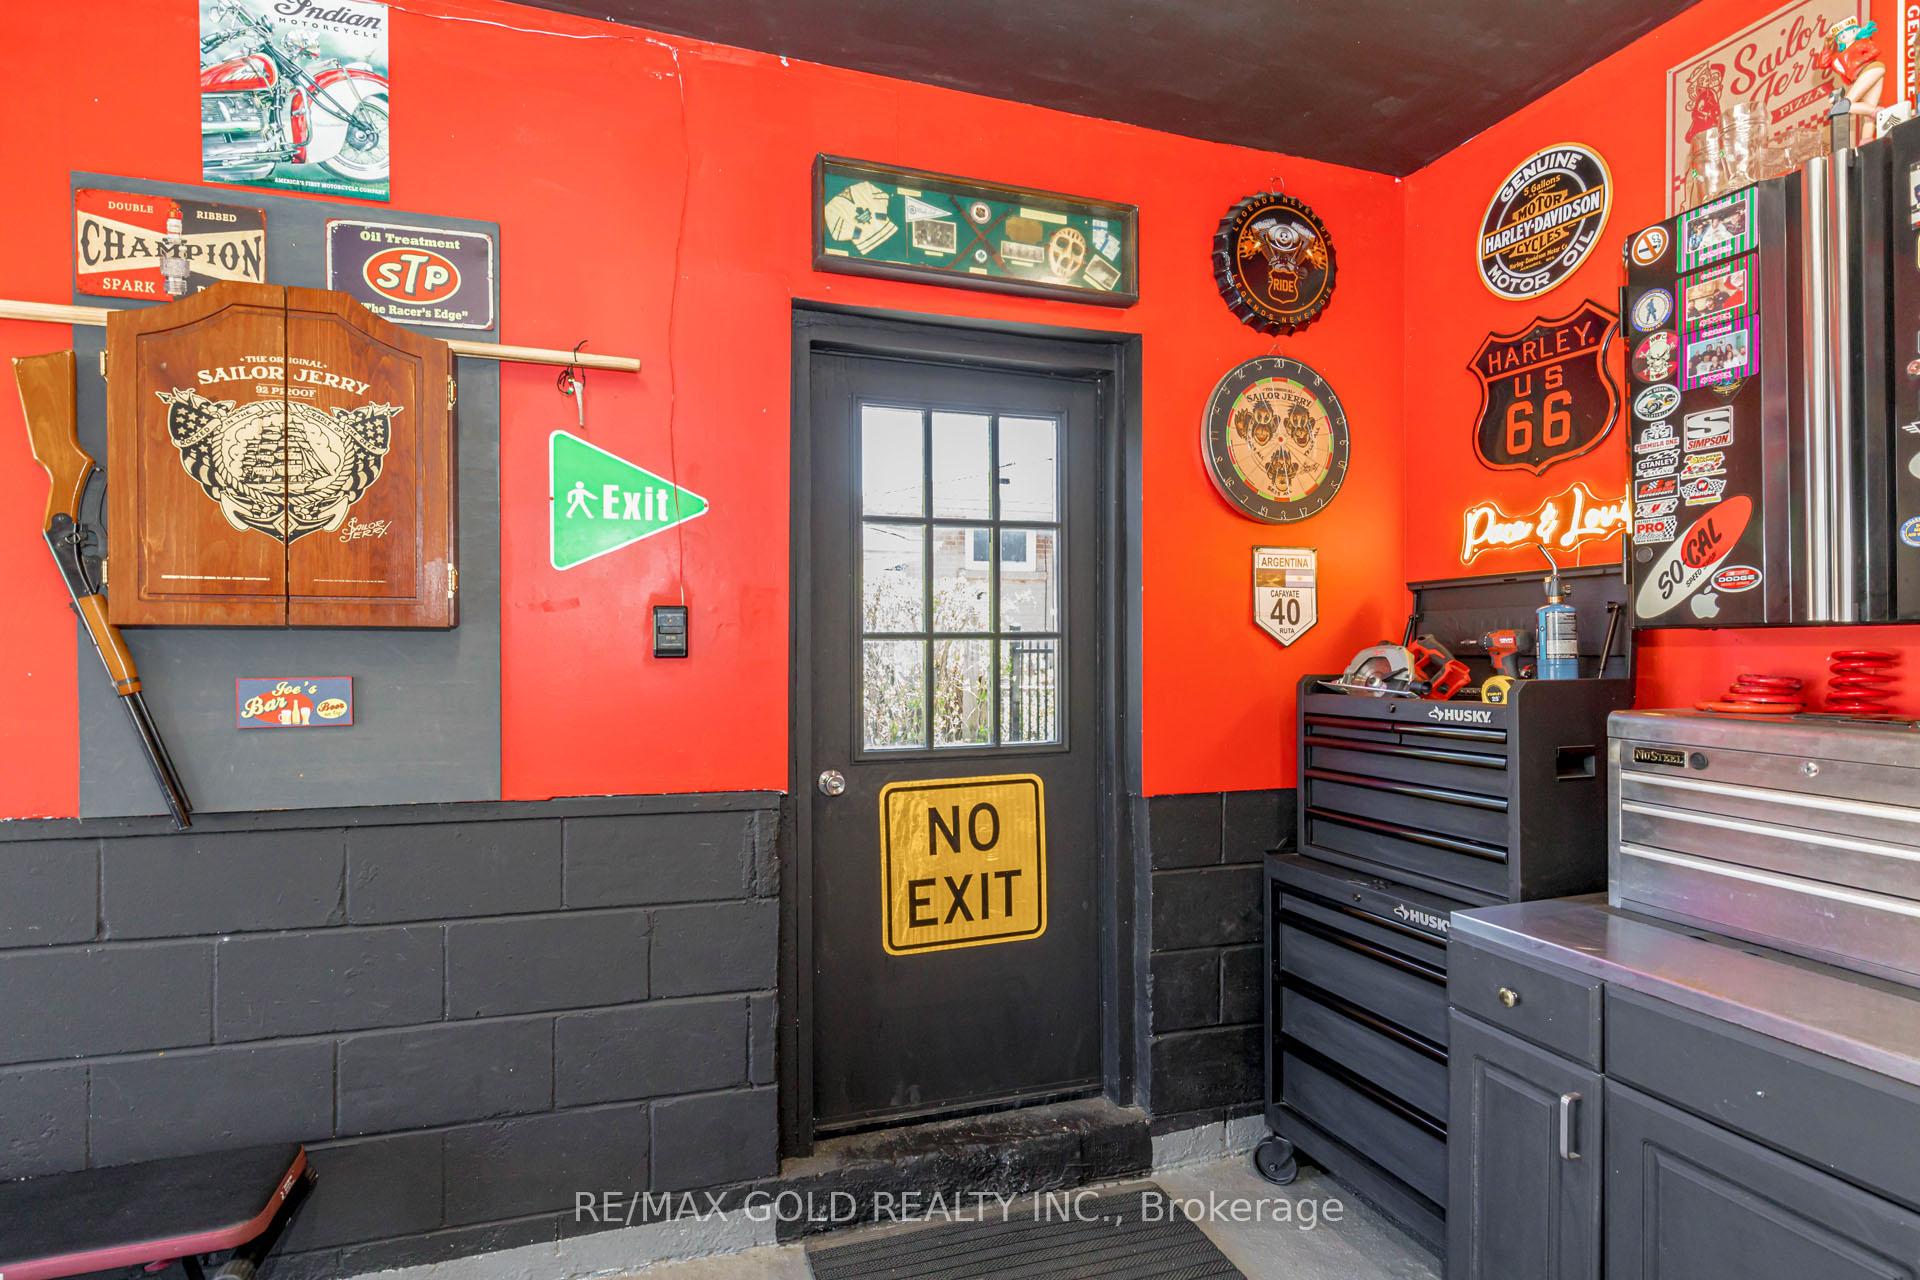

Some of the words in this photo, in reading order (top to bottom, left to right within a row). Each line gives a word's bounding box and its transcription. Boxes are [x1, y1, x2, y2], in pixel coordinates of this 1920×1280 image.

[274, 0, 382, 30] Indian
[278, 17, 378, 39] MOTORCYCLE
[1730, 14, 1833, 95] Sailor
[1780, 87, 1826, 116] PIZZA
[1500, 151, 1583, 203] GENUINE
[1523, 186, 1529, 197] 5
[1530, 174, 1561, 193] Gallons
[108, 201, 154, 214] DOUBLE
[196, 210, 237, 222] RIBBED
[1518, 193, 1562, 221] MOTOR
[1233, 196, 1275, 232] LEGENDS
[1283, 196, 1317, 222] NEVER
[1320, 225, 1332, 246] DIE
[1485, 191, 1600, 254] HARLEY-DAVIDSON
[80, 219, 262, 282] CHAMPION
[360, 230, 381, 243] Oil
[385, 233, 461, 250] Treatment
[1516, 228, 1562, 254] CYCLES
[1487, 263, 1551, 292] MOTOR
[1563, 229, 1595, 267] OIL
[102, 277, 156, 294] SPARK
[376, 254, 449, 294] STP
[1273, 279, 1294, 293] RIDE
[1232, 274, 1275, 320] LEGENDS
[1281, 308, 1317, 324] NEVER
[1319, 287, 1332, 306] DIE
[389, 305, 432, 318] Racer's
[1488, 320, 1593, 374] HARLEY
[244, 355, 268, 364] THE
[268, 356, 324, 369] ORIGINAL
[197, 365, 285, 385] SAILOR
[293, 369, 371, 396] JERRY
[255, 384, 269, 395] 92
[270, 386, 317, 398] PROOF
[1246, 391, 1280, 403] SAILOR
[1281, 392, 1313, 408] JERRY
[225, 417, 236, 427] IN
[237, 409, 252, 420] THE
[305, 410, 333, 428] CRADLE
[334, 426, 343, 434] OF
[1505, 390, 1573, 455] 66
[180, 426, 211, 446] ROCKED
[346, 426, 359, 439] THE
[1688, 435, 1728, 450] SIMPSON
[1636, 441, 1665, 450] FORMULA
[1640, 458, 1674, 470] STANLEY
[602, 484, 669, 522] Exit
[1637, 521, 1665, 534] PRO
[1261, 557, 1309, 568] ARGENTINA
[1270, 590, 1300, 598] CAFAYATE
[1270, 598, 1300, 626] 40
[271, 680, 318, 697] Joe's
[240, 695, 288, 718] Bar
[927, 801, 1000, 856] NO
[907, 868, 1022, 929] EXIT
